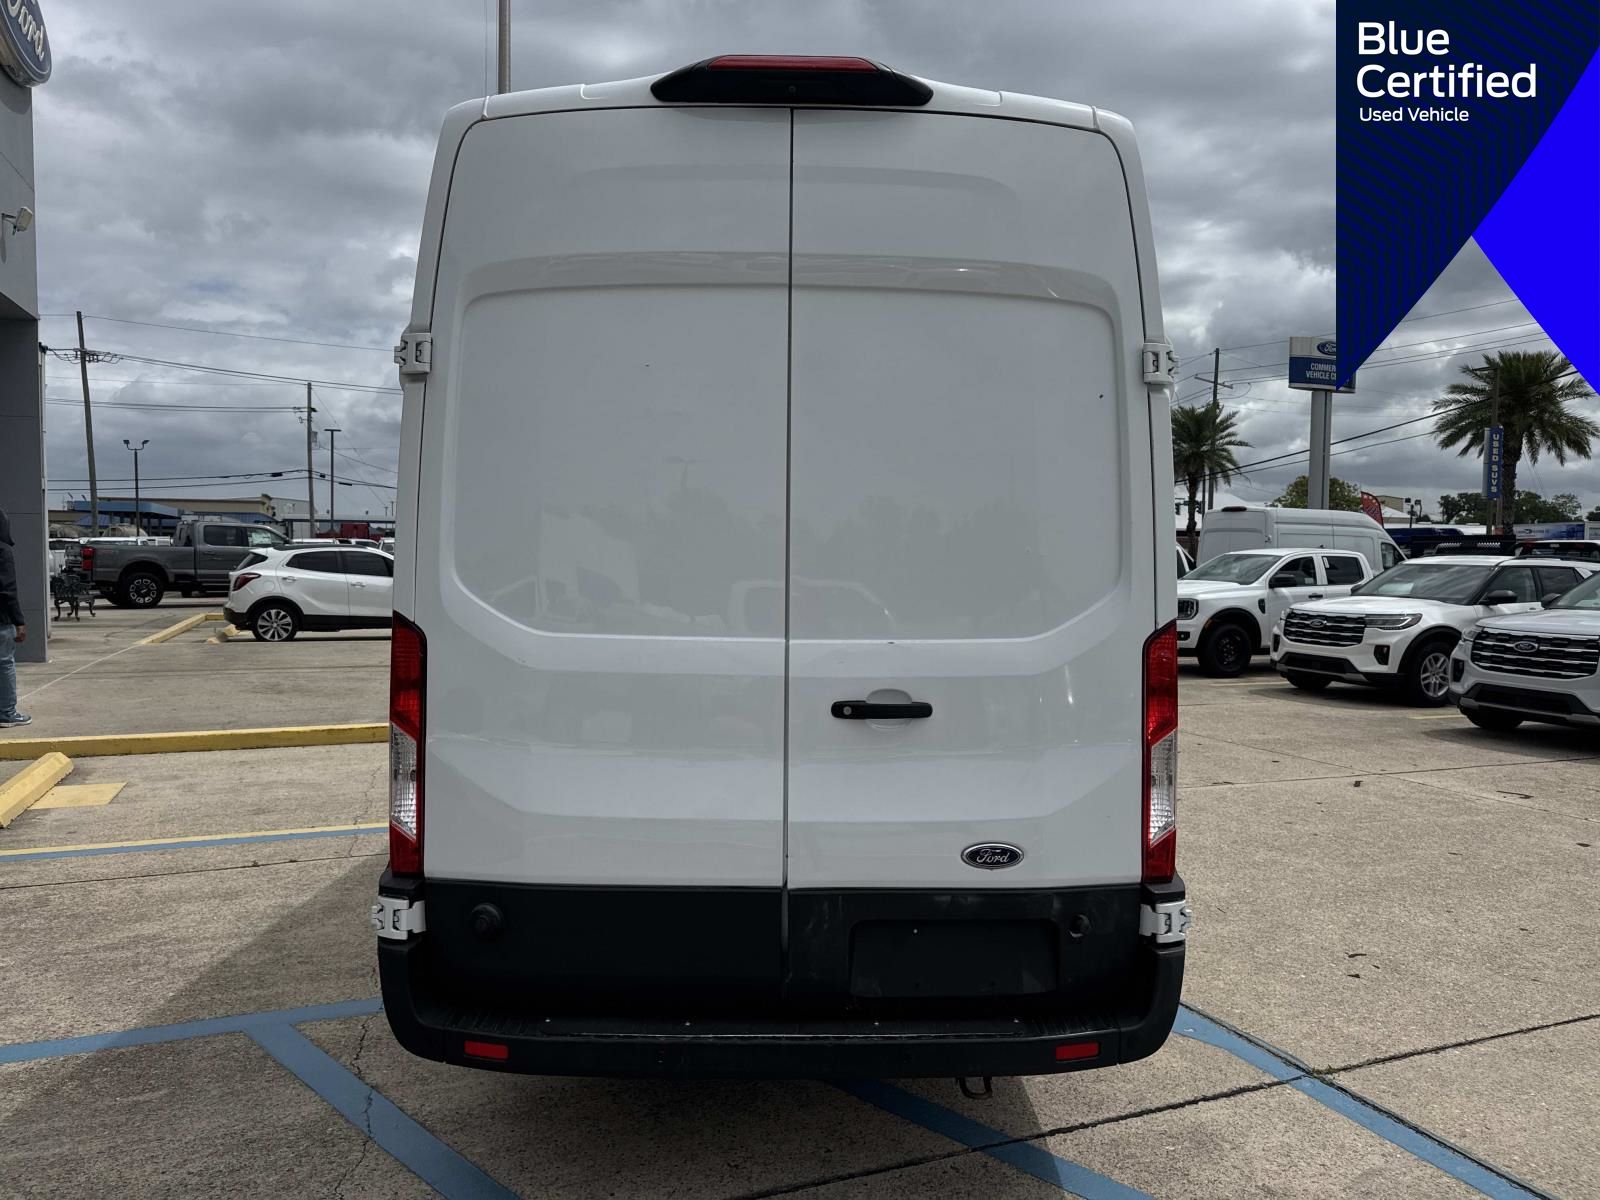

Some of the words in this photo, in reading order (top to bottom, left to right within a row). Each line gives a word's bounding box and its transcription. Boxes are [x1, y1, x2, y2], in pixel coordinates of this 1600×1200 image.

[1305, 370, 1329, 380] VEHICLE
[1492, 433, 1500, 462] USED
[976, 848, 1010, 863] Ford
